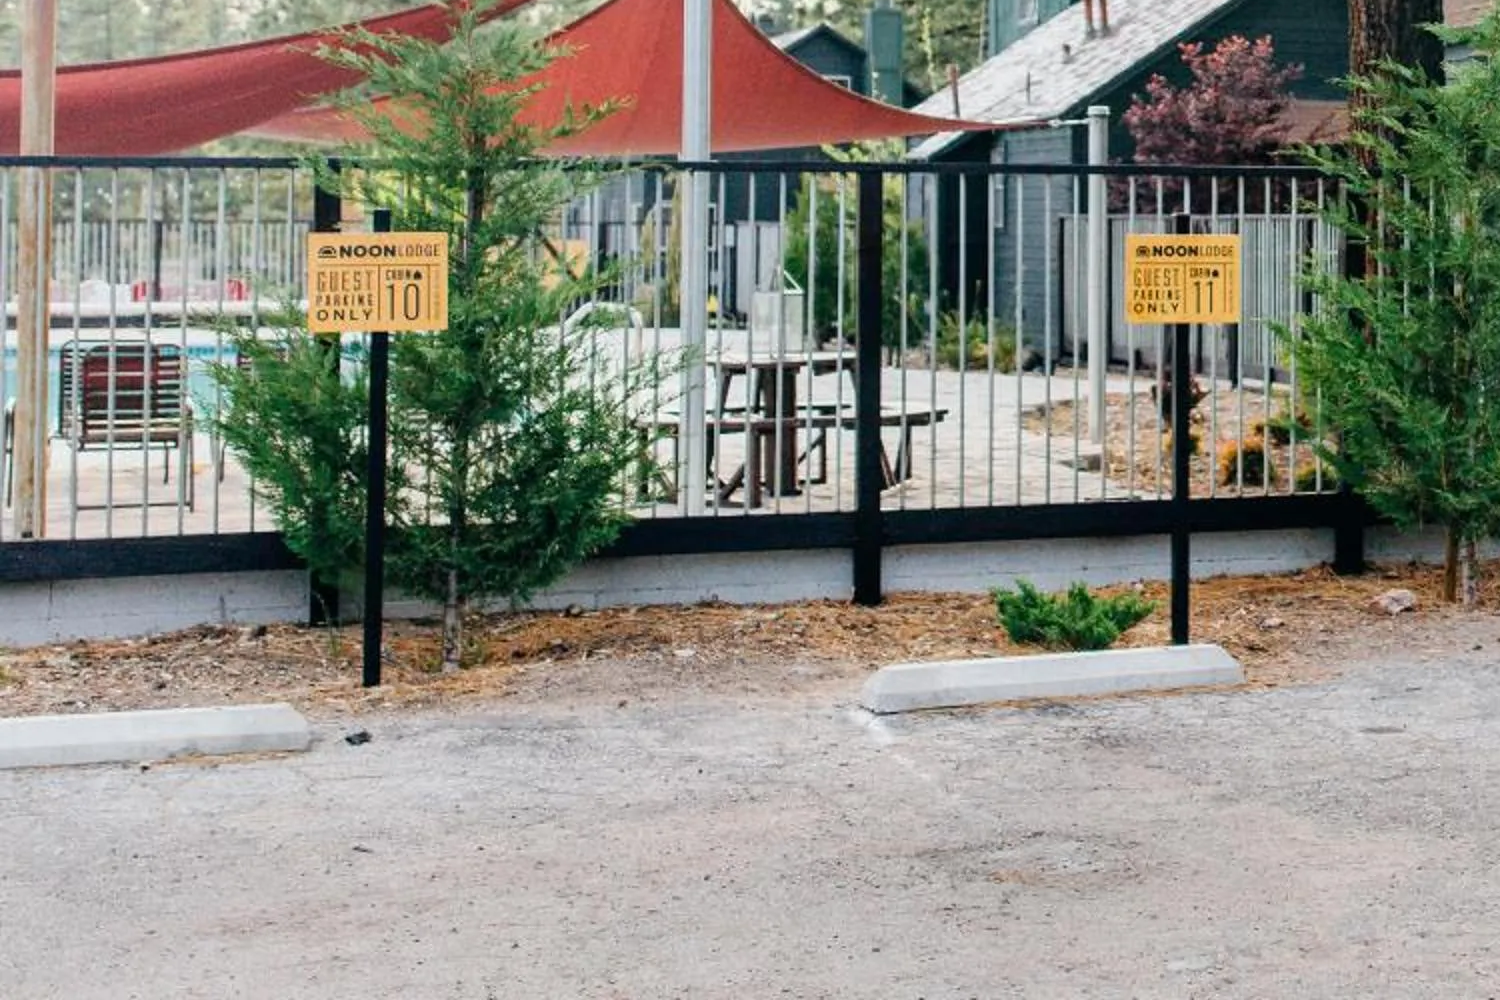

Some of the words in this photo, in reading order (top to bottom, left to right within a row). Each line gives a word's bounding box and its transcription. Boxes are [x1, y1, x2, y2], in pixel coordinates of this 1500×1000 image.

[317, 270, 374, 292] GUEST
[386, 283, 419, 321] 10
[1194, 281, 1213, 313] 11
[317, 309, 373, 321] ONLY
[1133, 303, 1179, 314] ONLY
